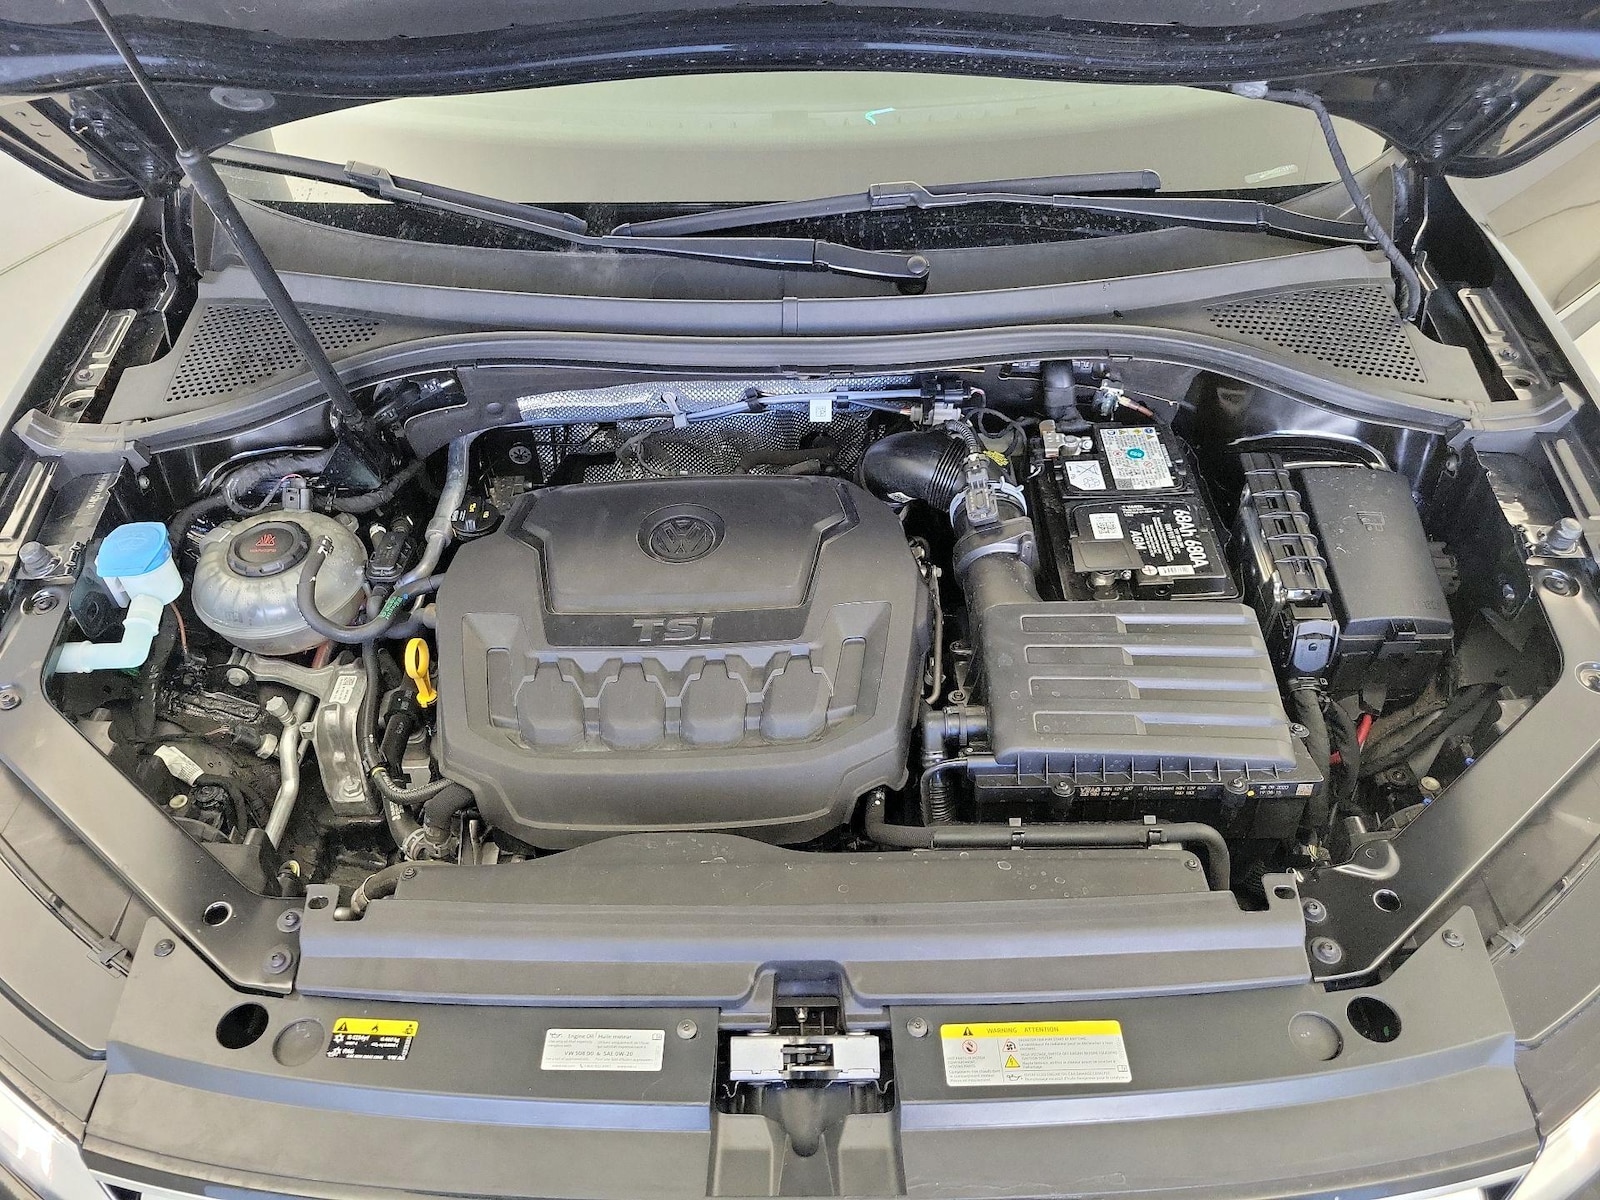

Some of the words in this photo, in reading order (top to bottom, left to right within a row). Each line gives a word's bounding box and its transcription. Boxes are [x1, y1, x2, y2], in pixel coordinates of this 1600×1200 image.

[1173, 509, 1198, 537] 68Ah
[1129, 530, 1147, 550] AGM
[1184, 539, 1209, 567] 680A
[632, 617, 715, 642] TSI
